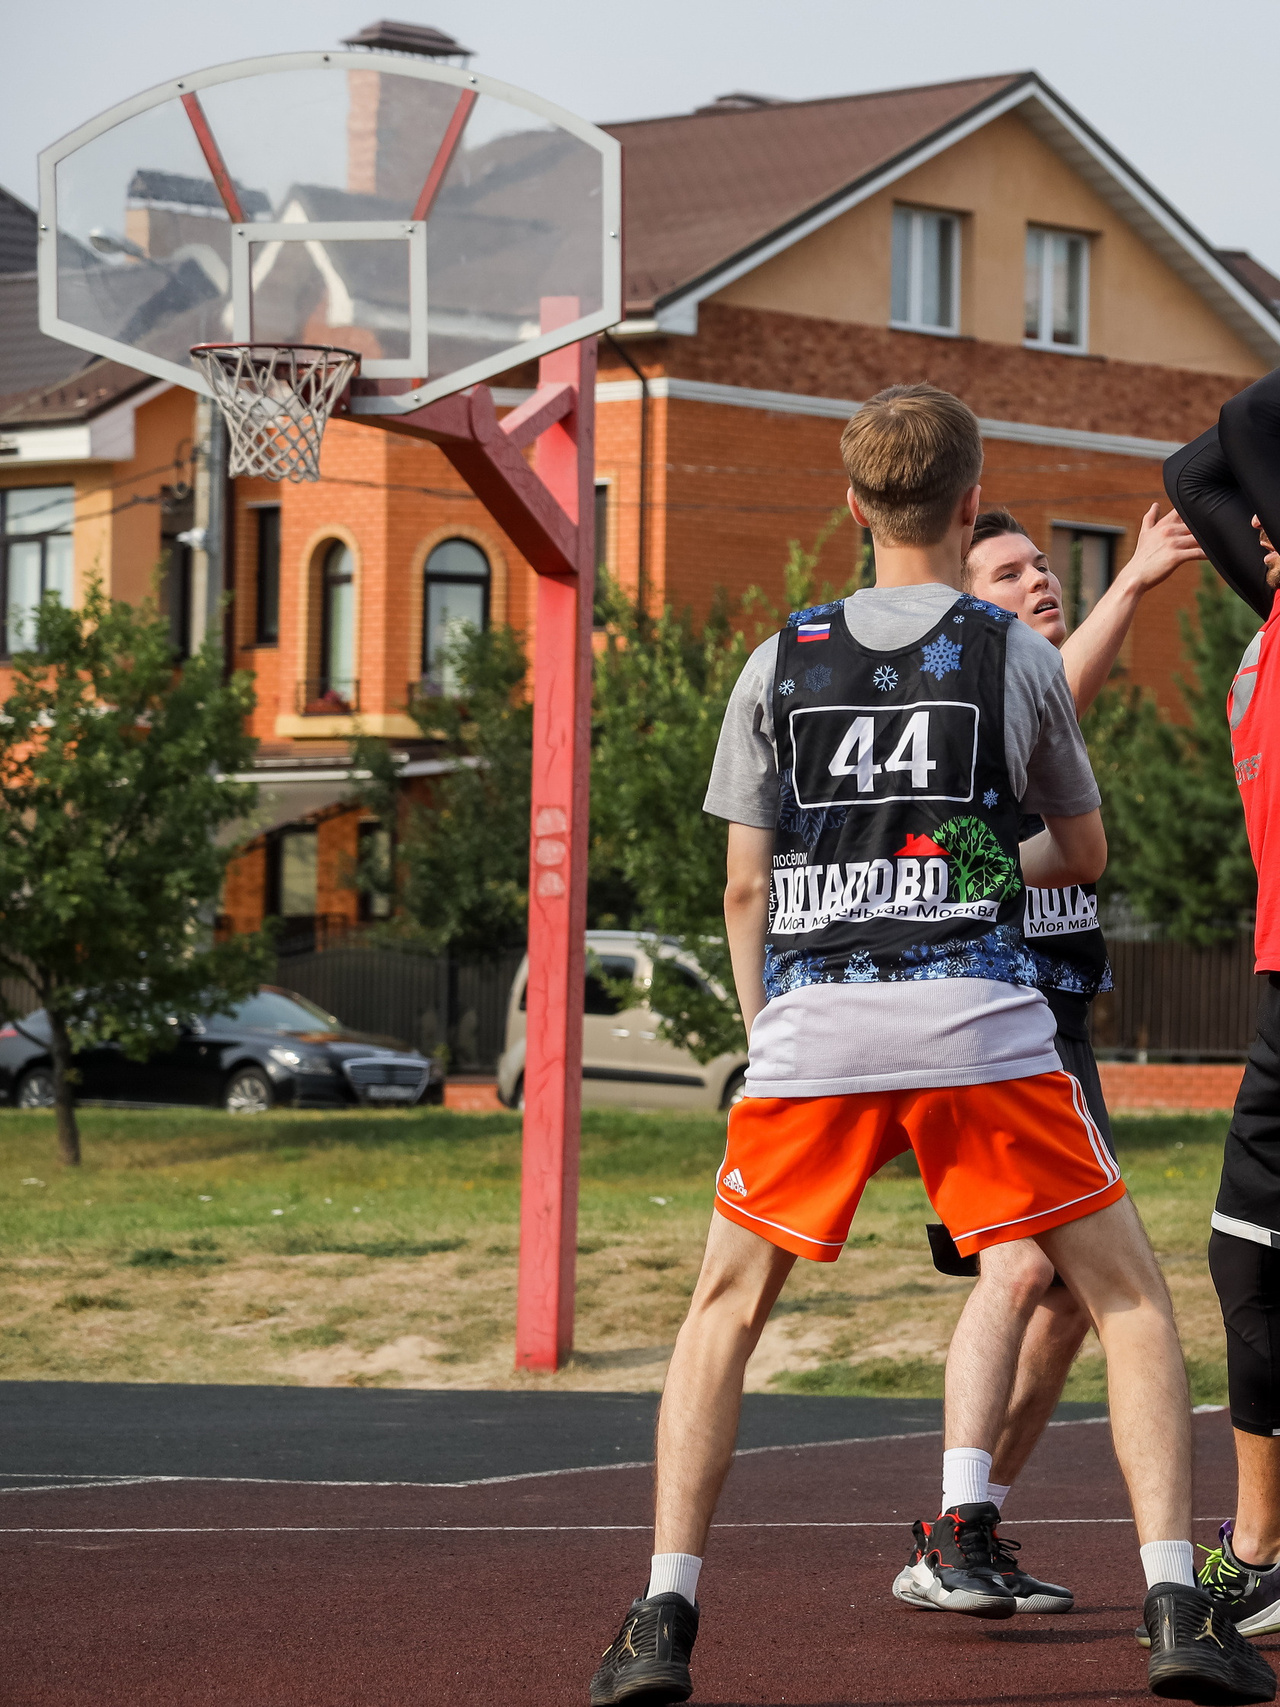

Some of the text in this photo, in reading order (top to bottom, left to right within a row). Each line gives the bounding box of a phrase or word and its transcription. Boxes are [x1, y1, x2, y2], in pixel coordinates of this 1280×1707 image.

[828, 711, 937, 792] 44
[773, 849, 808, 867] посёлок
[773, 858, 949, 914] ПОТАПОВО
[778, 916, 805, 930] Моя
[916, 904, 996, 918] Москва
[1029, 921, 1064, 934] Моя
[722, 1177, 748, 1197] adidas
